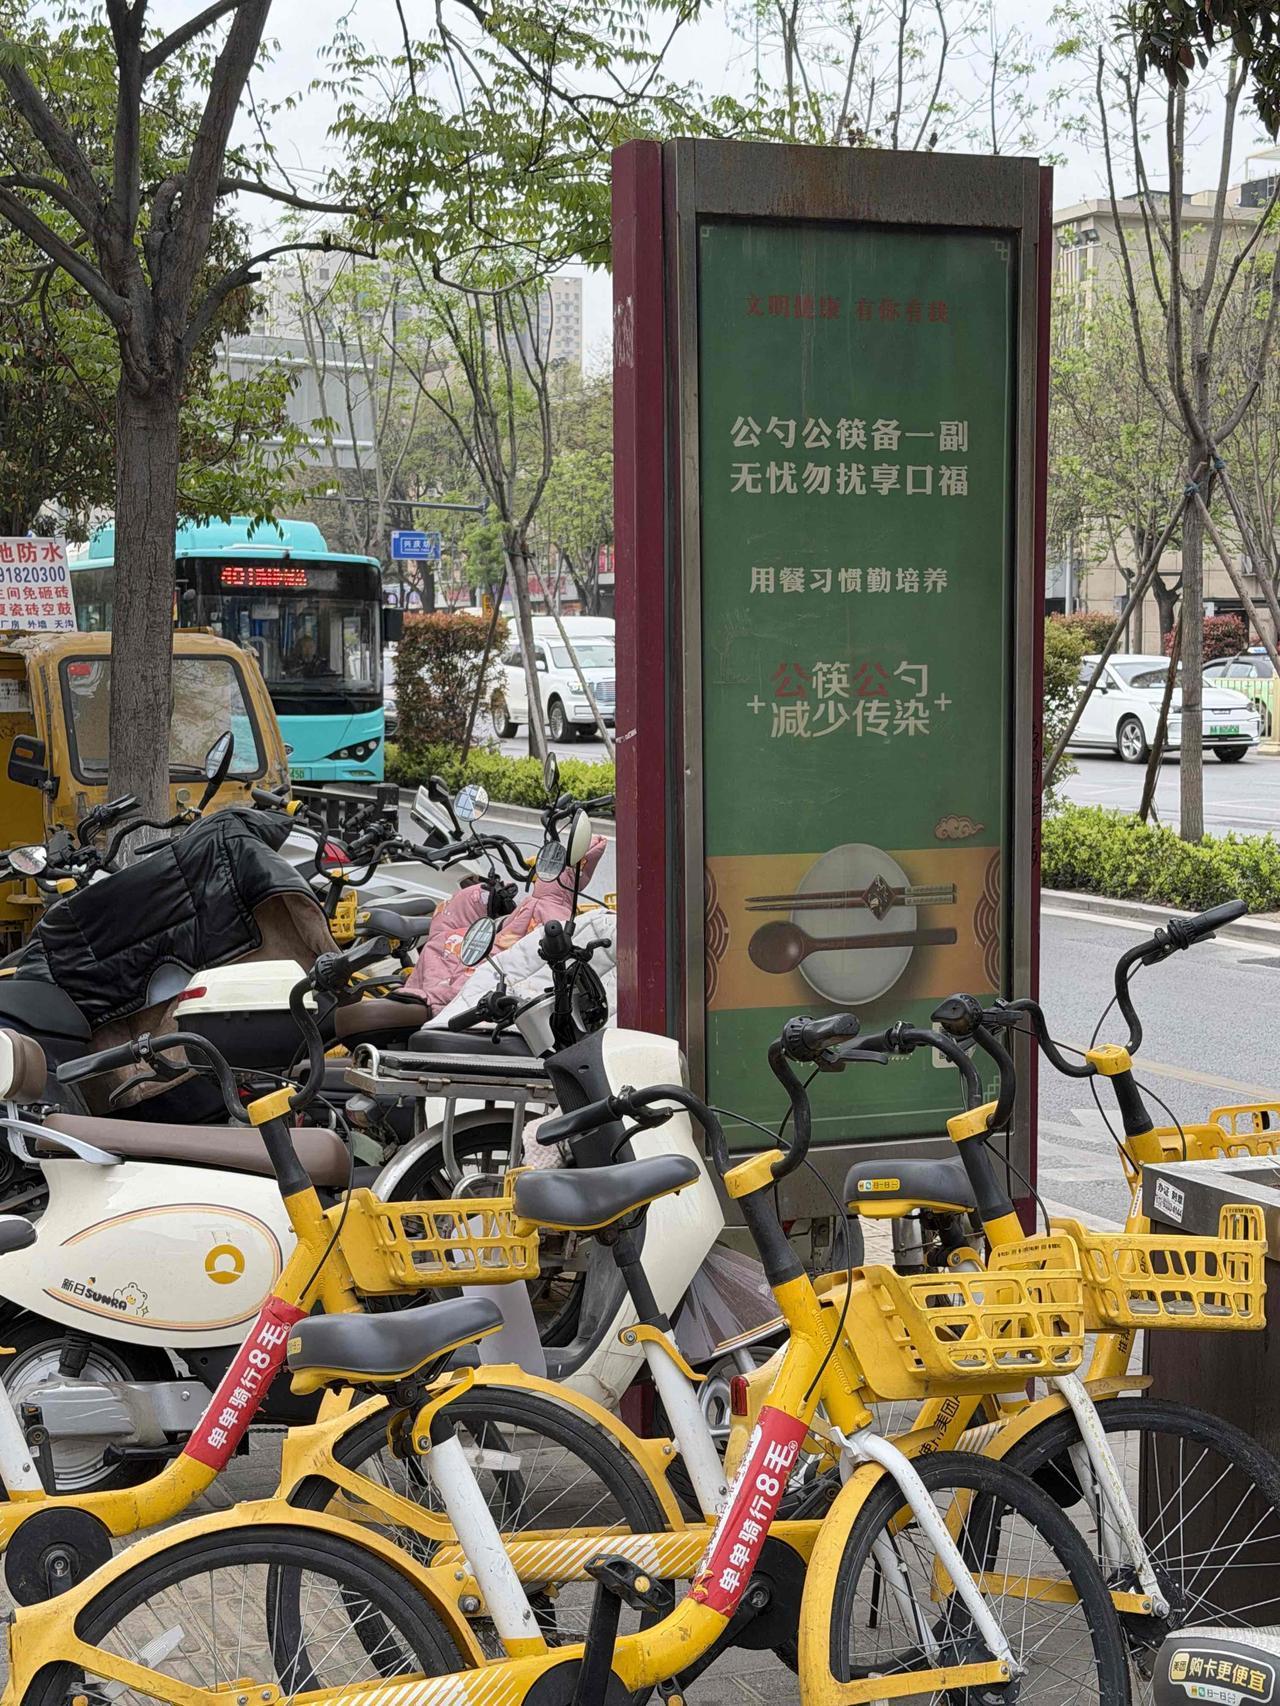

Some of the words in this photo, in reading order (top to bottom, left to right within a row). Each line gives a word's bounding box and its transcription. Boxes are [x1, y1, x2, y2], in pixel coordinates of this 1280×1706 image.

[747, 293, 840, 319] 文明健康
[856, 298, 949, 323] 有你有我
[730, 416, 969, 452] 公勺公筷备一副
[730, 461, 969, 496] 无忧勿扰享口福
[749, 566, 948, 594] 用餐习惯勤培养
[772, 660, 928, 699] 公筷公勺
[771, 699, 930, 738] 减少传染
[1188, 1657, 1266, 1693] 购卡更便宜
